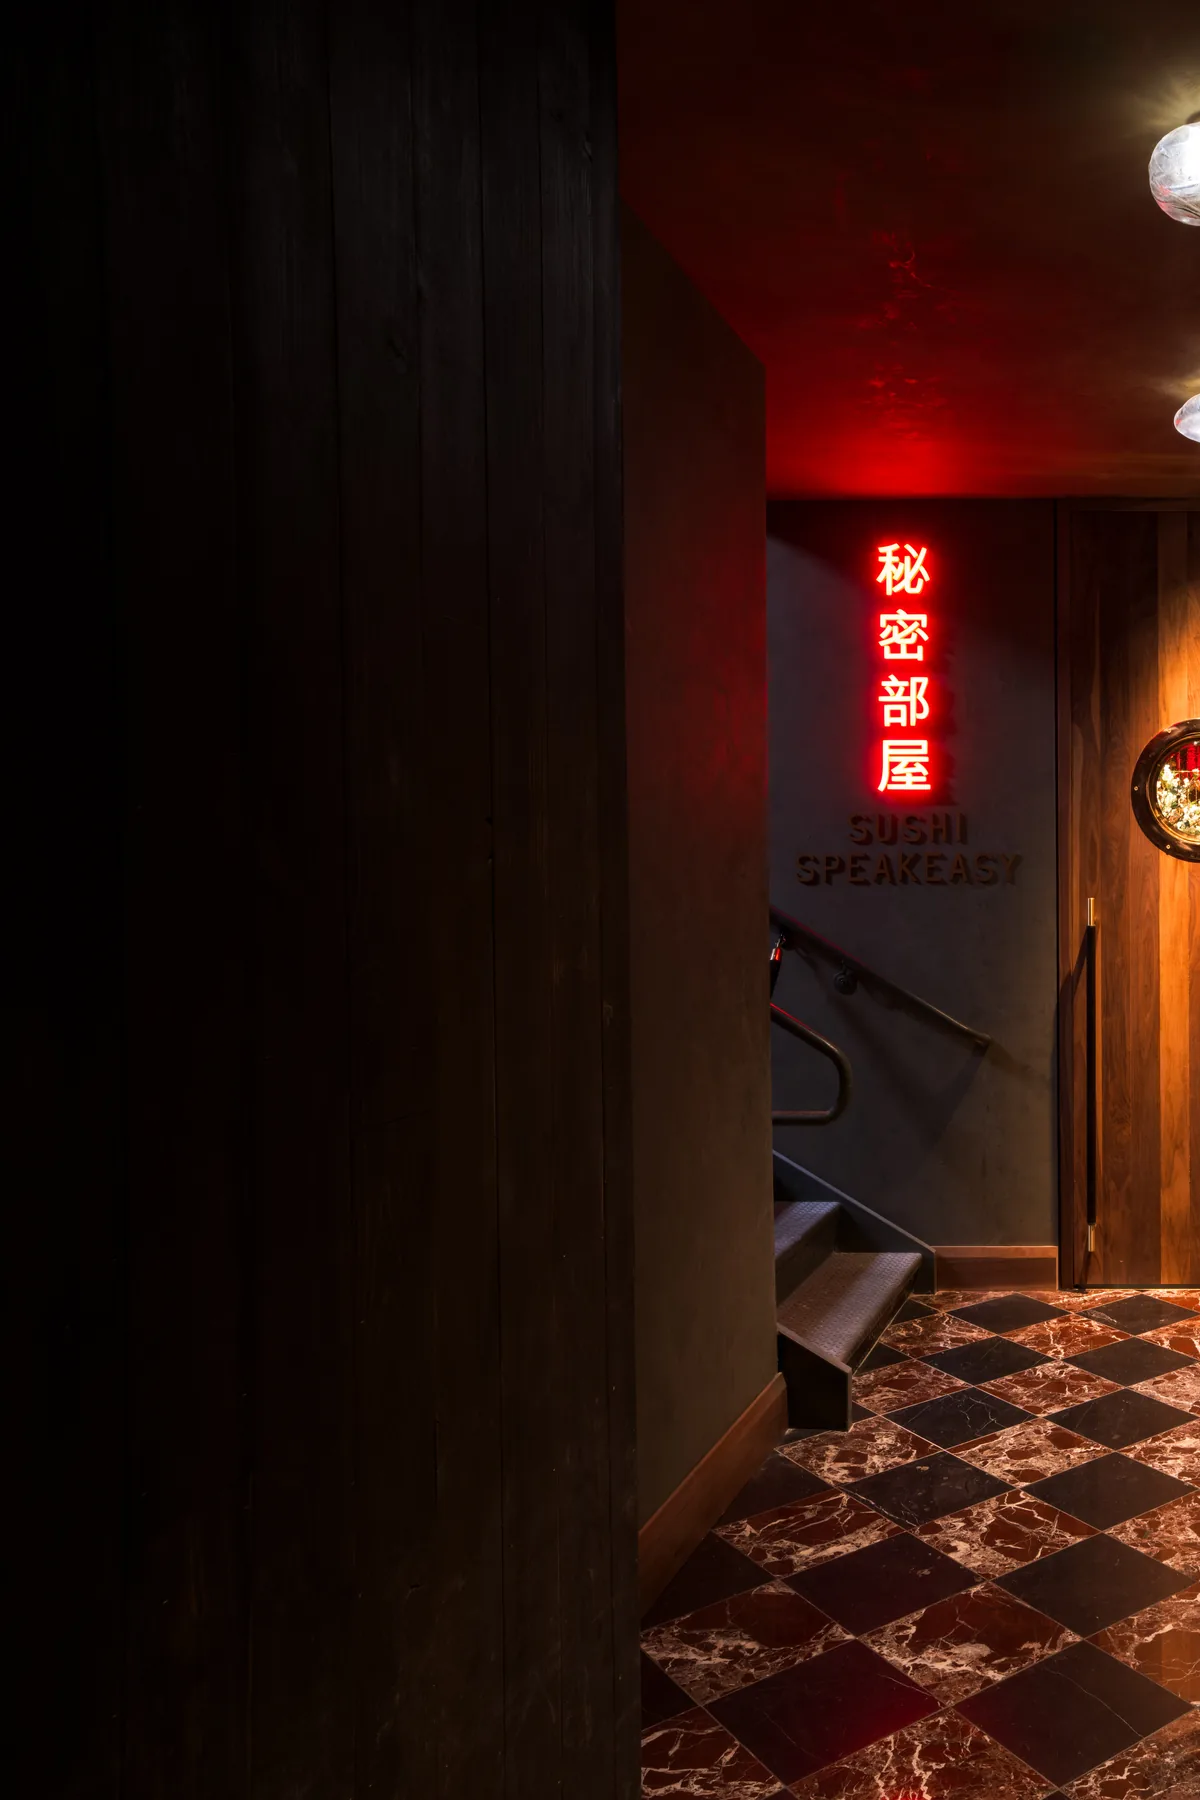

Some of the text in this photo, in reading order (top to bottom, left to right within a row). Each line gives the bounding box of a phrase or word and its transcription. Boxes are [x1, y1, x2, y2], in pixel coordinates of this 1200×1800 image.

[875, 542, 932, 793] 秘密部屋
[850, 813, 969, 845] SUSHI
[797, 852, 1022, 885] SPEAKEASY
